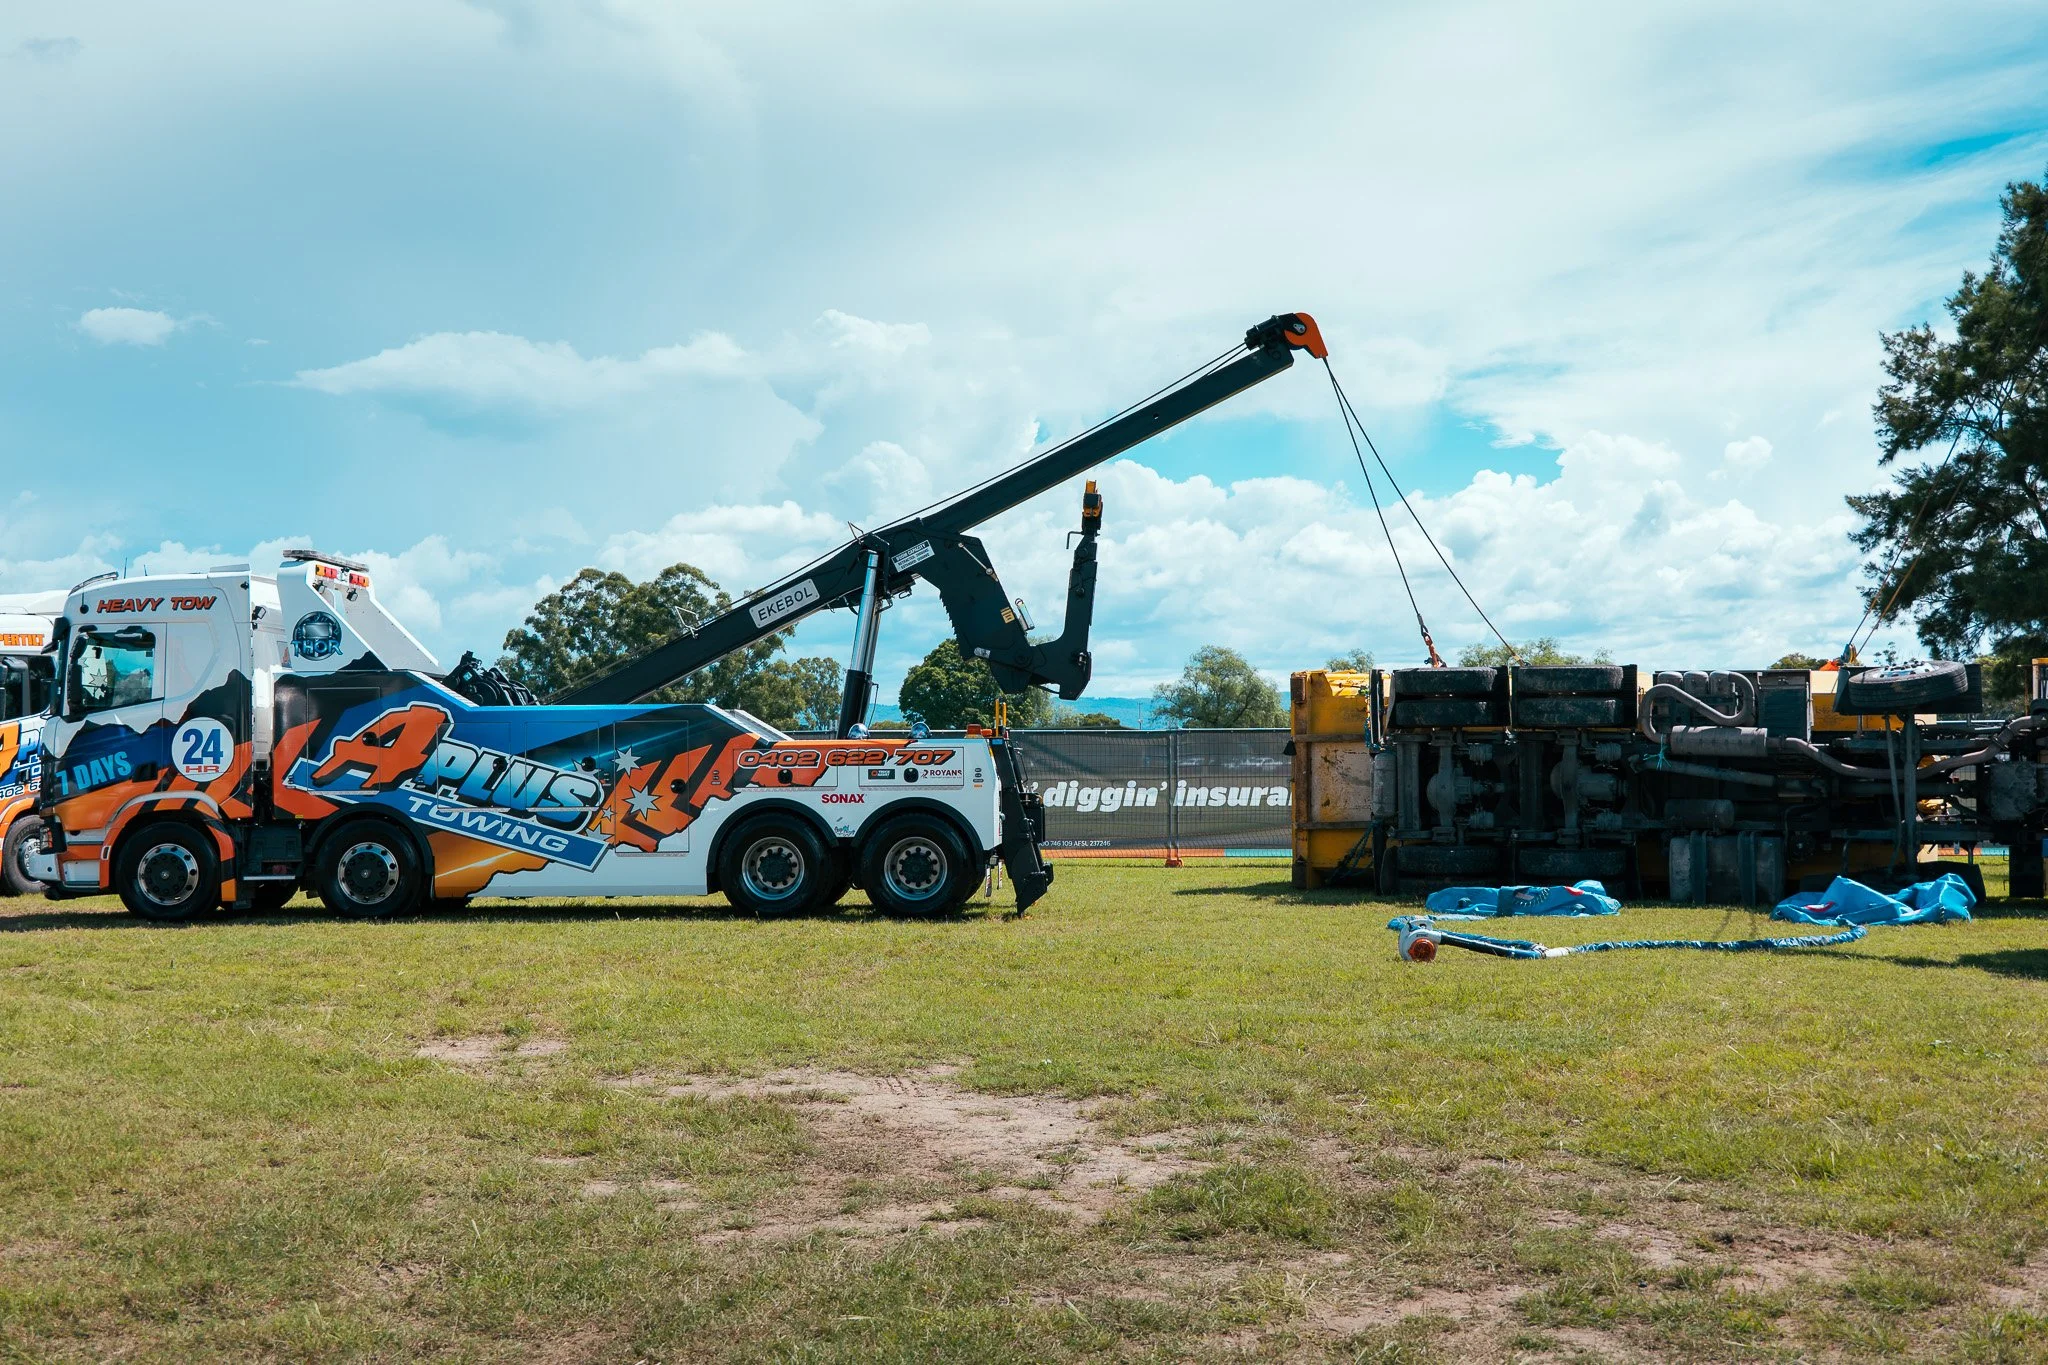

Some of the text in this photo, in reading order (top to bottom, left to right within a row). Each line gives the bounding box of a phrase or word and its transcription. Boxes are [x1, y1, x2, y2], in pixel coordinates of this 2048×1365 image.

[97, 596, 217, 614] HEAVY TOW
[758, 587, 812, 621] EKEBOL
[291, 639, 344, 657] THOR
[182, 728, 224, 764] 24
[738, 750, 956, 768] 0402 622 707
[56, 752, 132, 795] 7 DAYS
[185, 765, 220, 773] HR
[419, 742, 601, 829] PLUS
[822, 794, 865, 804] SONAX
[1043, 780, 1168, 812] diggin’
[1173, 780, 1292, 806] insura
[408, 796, 571, 852] TOWING
